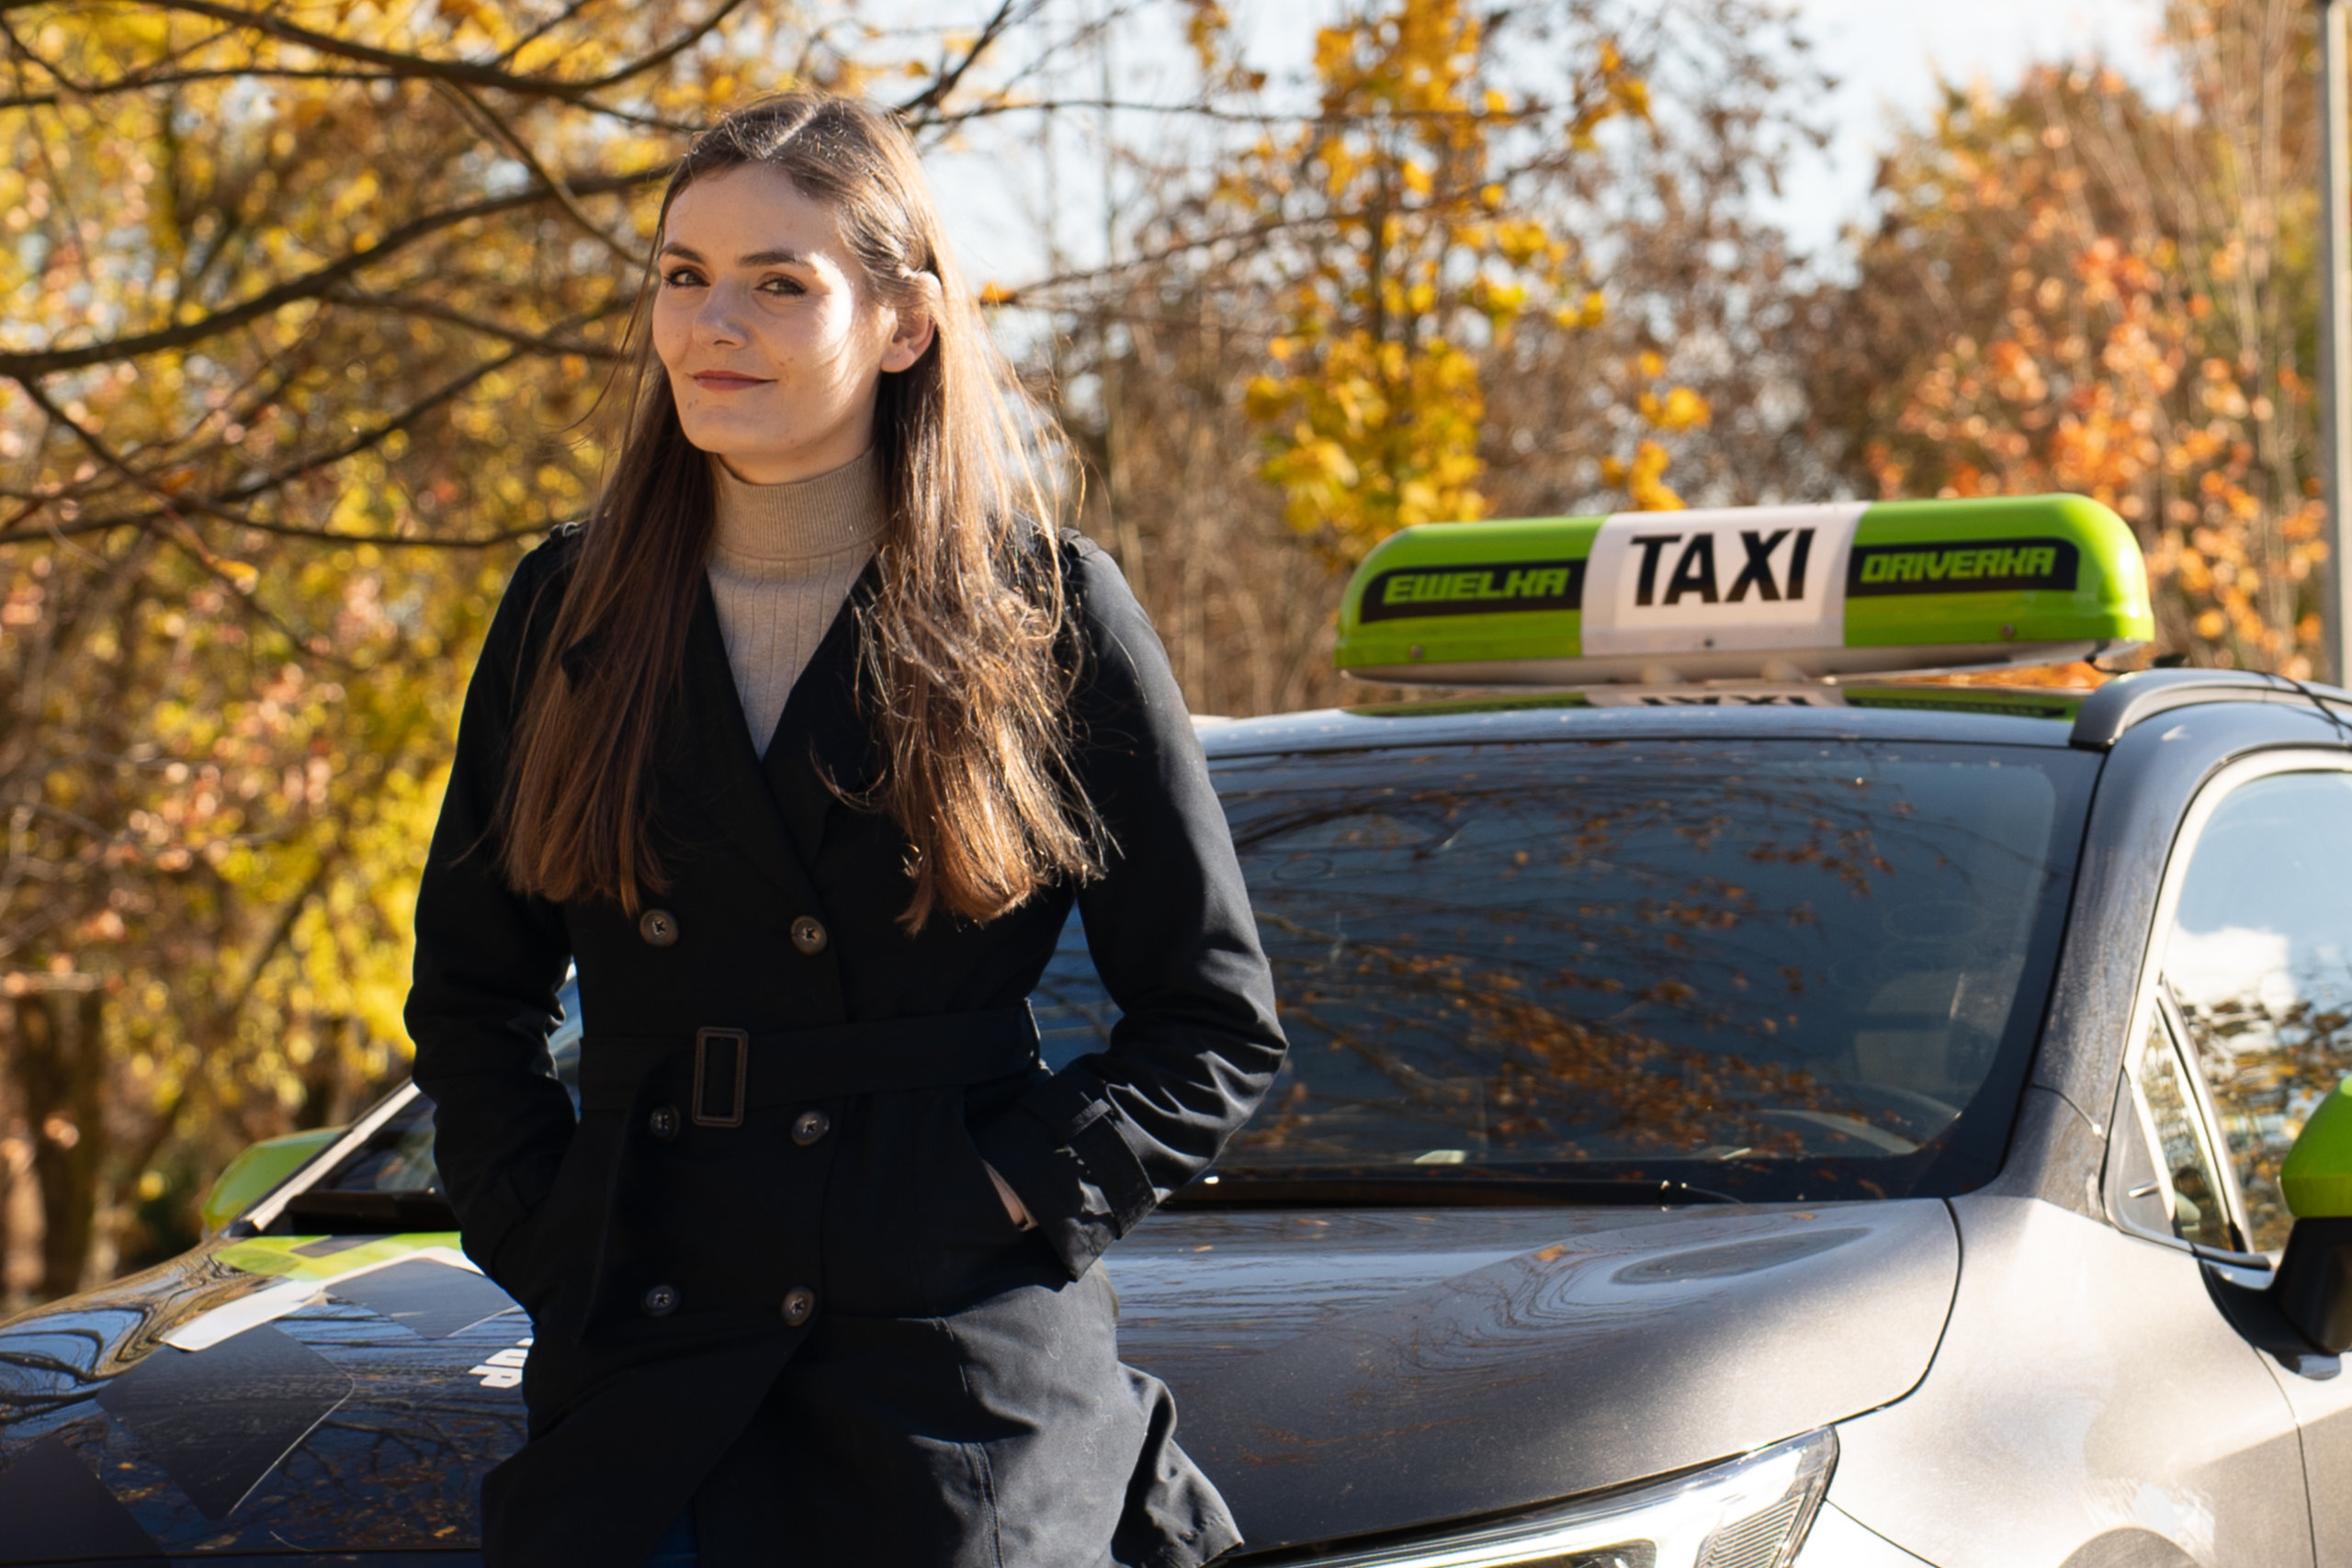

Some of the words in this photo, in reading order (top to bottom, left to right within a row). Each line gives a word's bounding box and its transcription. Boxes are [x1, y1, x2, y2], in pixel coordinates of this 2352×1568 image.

[1630, 527, 1816, 606] TAXI
[1860, 547, 2056, 583] DRIVERKA
[1383, 568, 1570, 605] EWELKA
